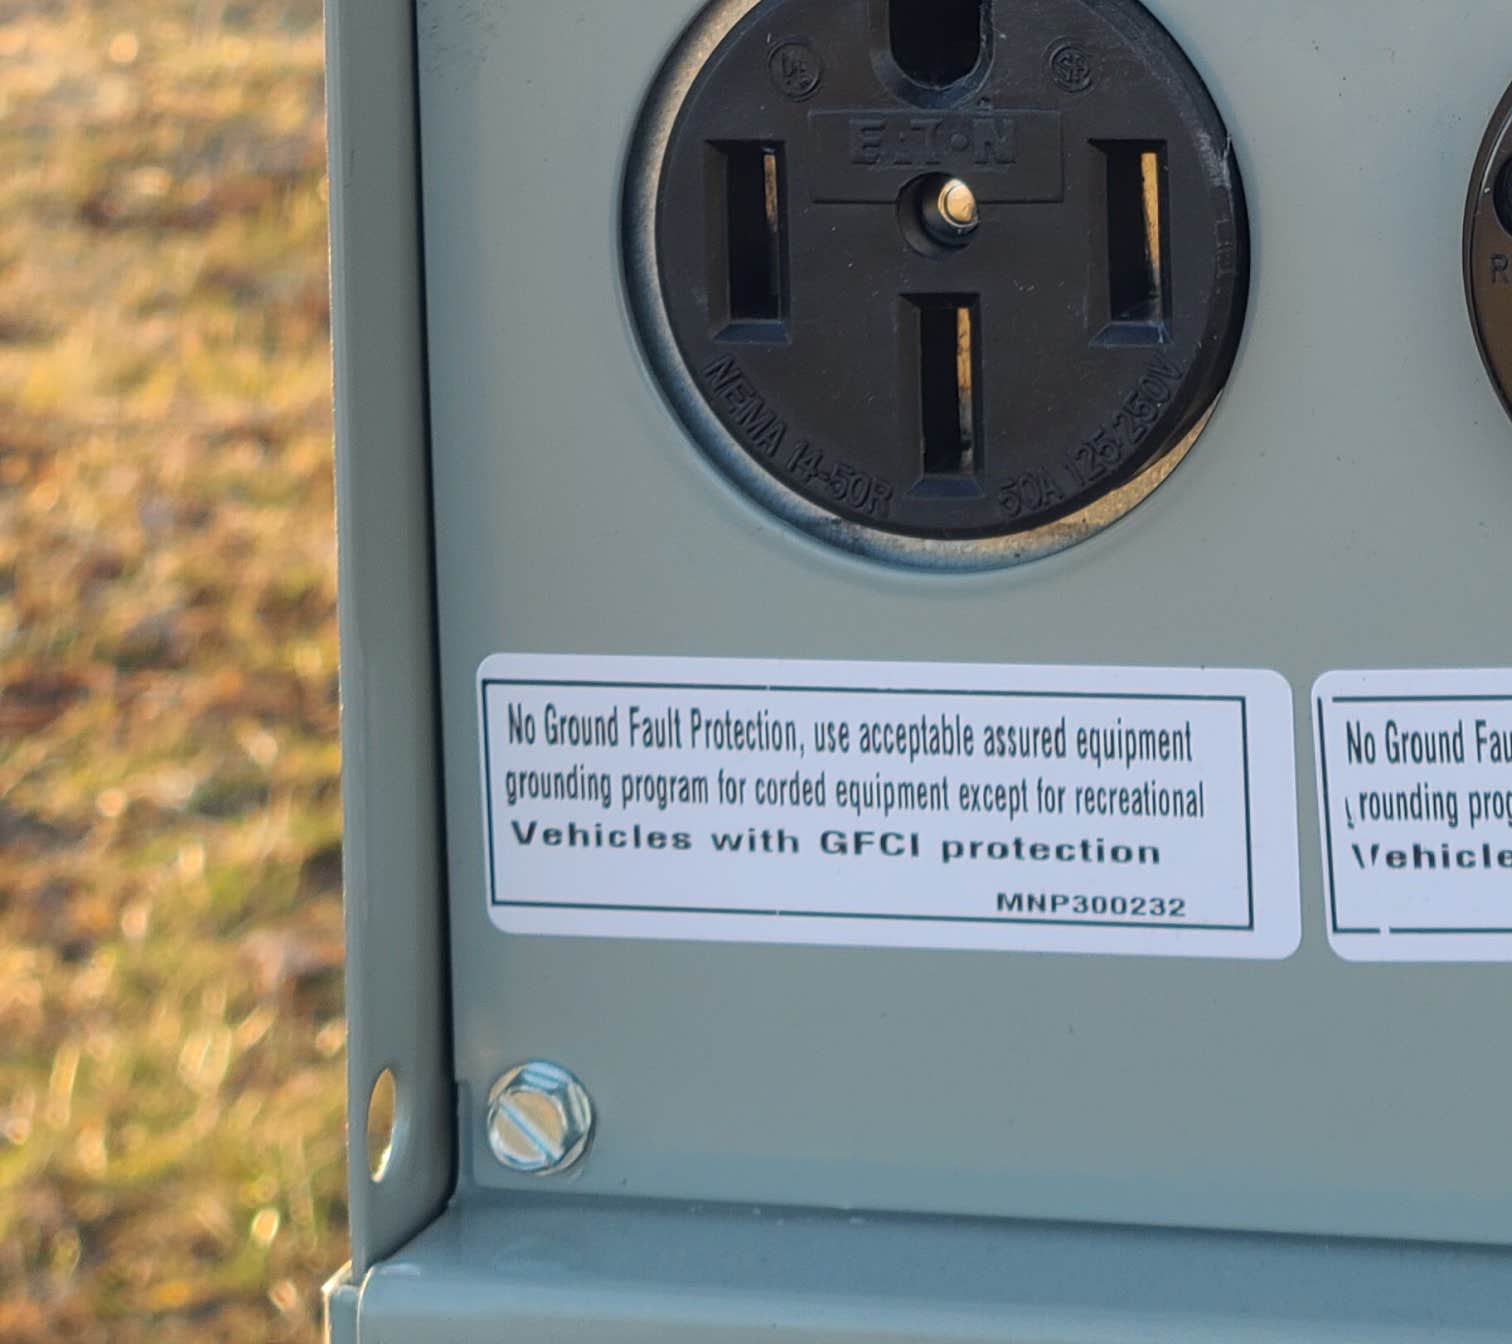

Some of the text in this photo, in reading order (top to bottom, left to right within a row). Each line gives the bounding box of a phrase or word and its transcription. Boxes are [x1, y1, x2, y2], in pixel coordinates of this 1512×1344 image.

[702, 351, 896, 519] NEMA 14-50R
[507, 702, 1193, 765] No Ground Fault Protection, use acceptable assured equipment
[1345, 721, 1376, 764] No
[1384, 719, 1465, 764] Ground
[505, 763, 1204, 821] grounding program for corded equipment except for recreational
[510, 820, 1160, 864] Vehicles with GFCI protection
[996, 893, 1185, 917] MNP300232
